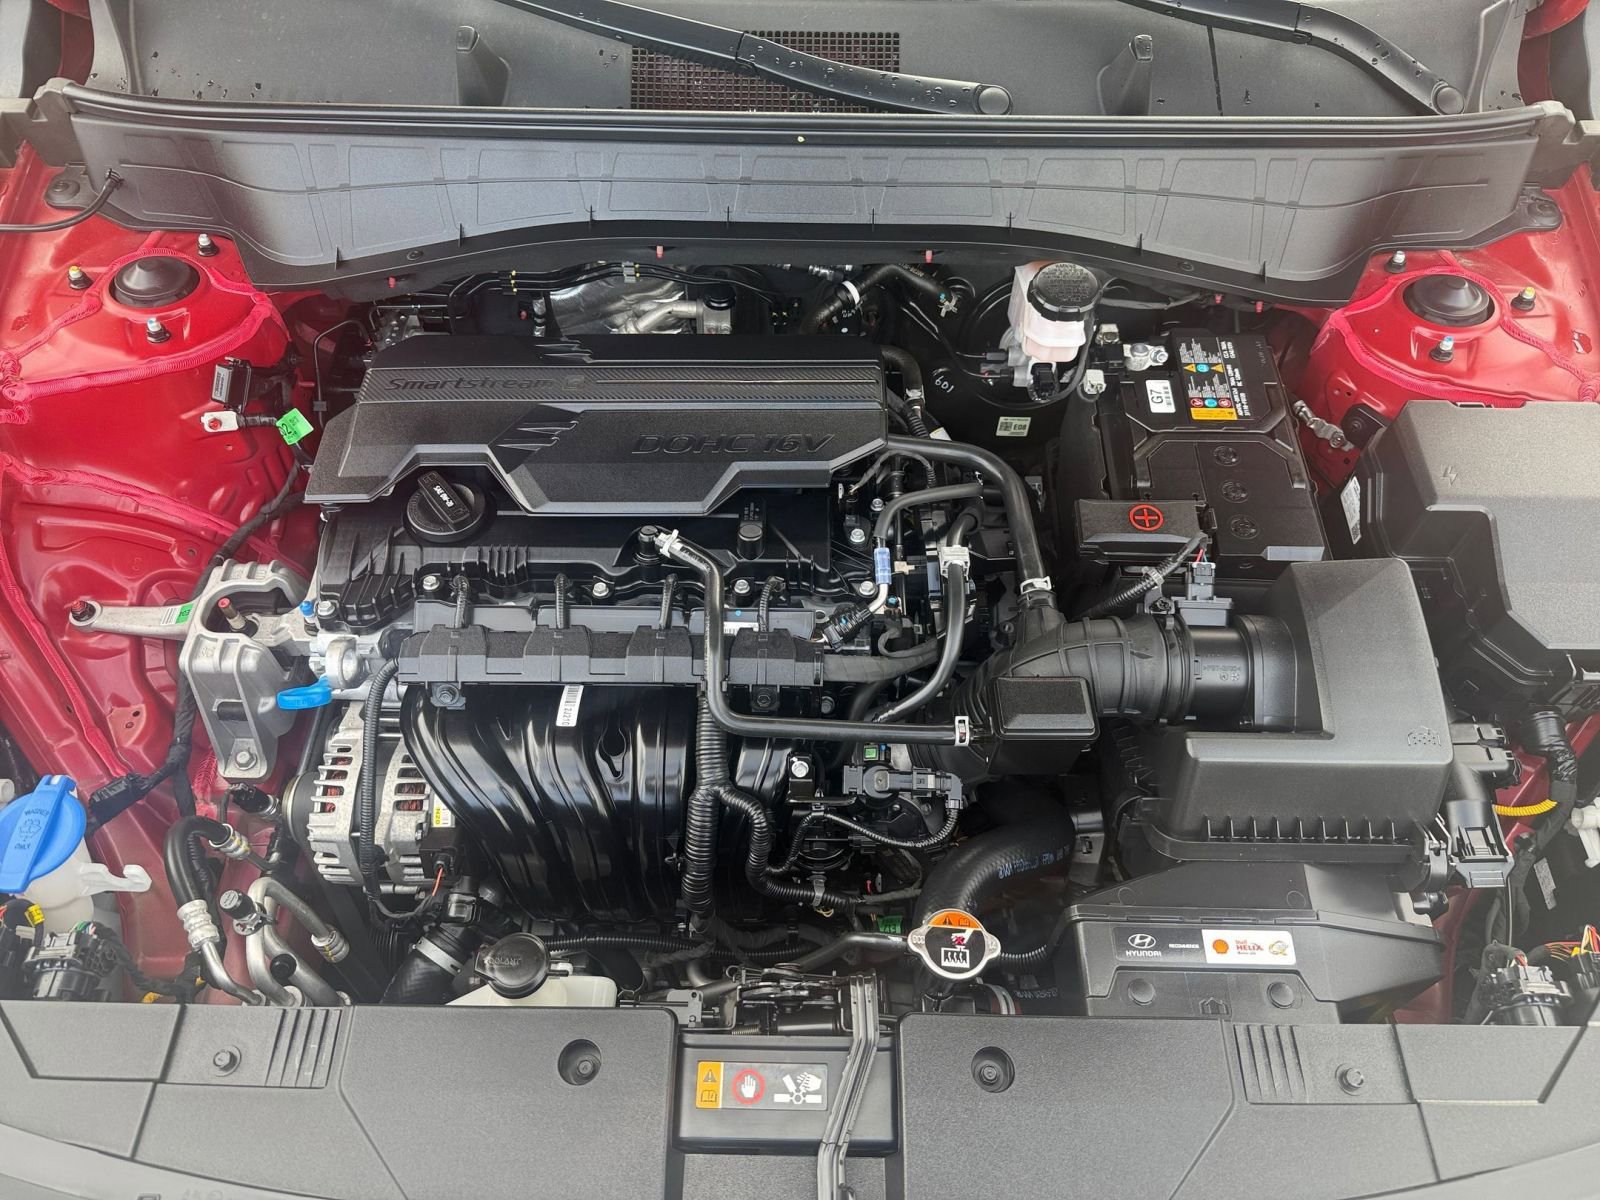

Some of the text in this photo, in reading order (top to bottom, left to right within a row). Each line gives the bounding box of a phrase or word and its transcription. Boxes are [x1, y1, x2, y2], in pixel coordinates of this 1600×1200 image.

[384, 376, 554, 391] Smartstream
[1150, 389, 1164, 404] G7
[632, 433, 835, 454] DOHC 16V
